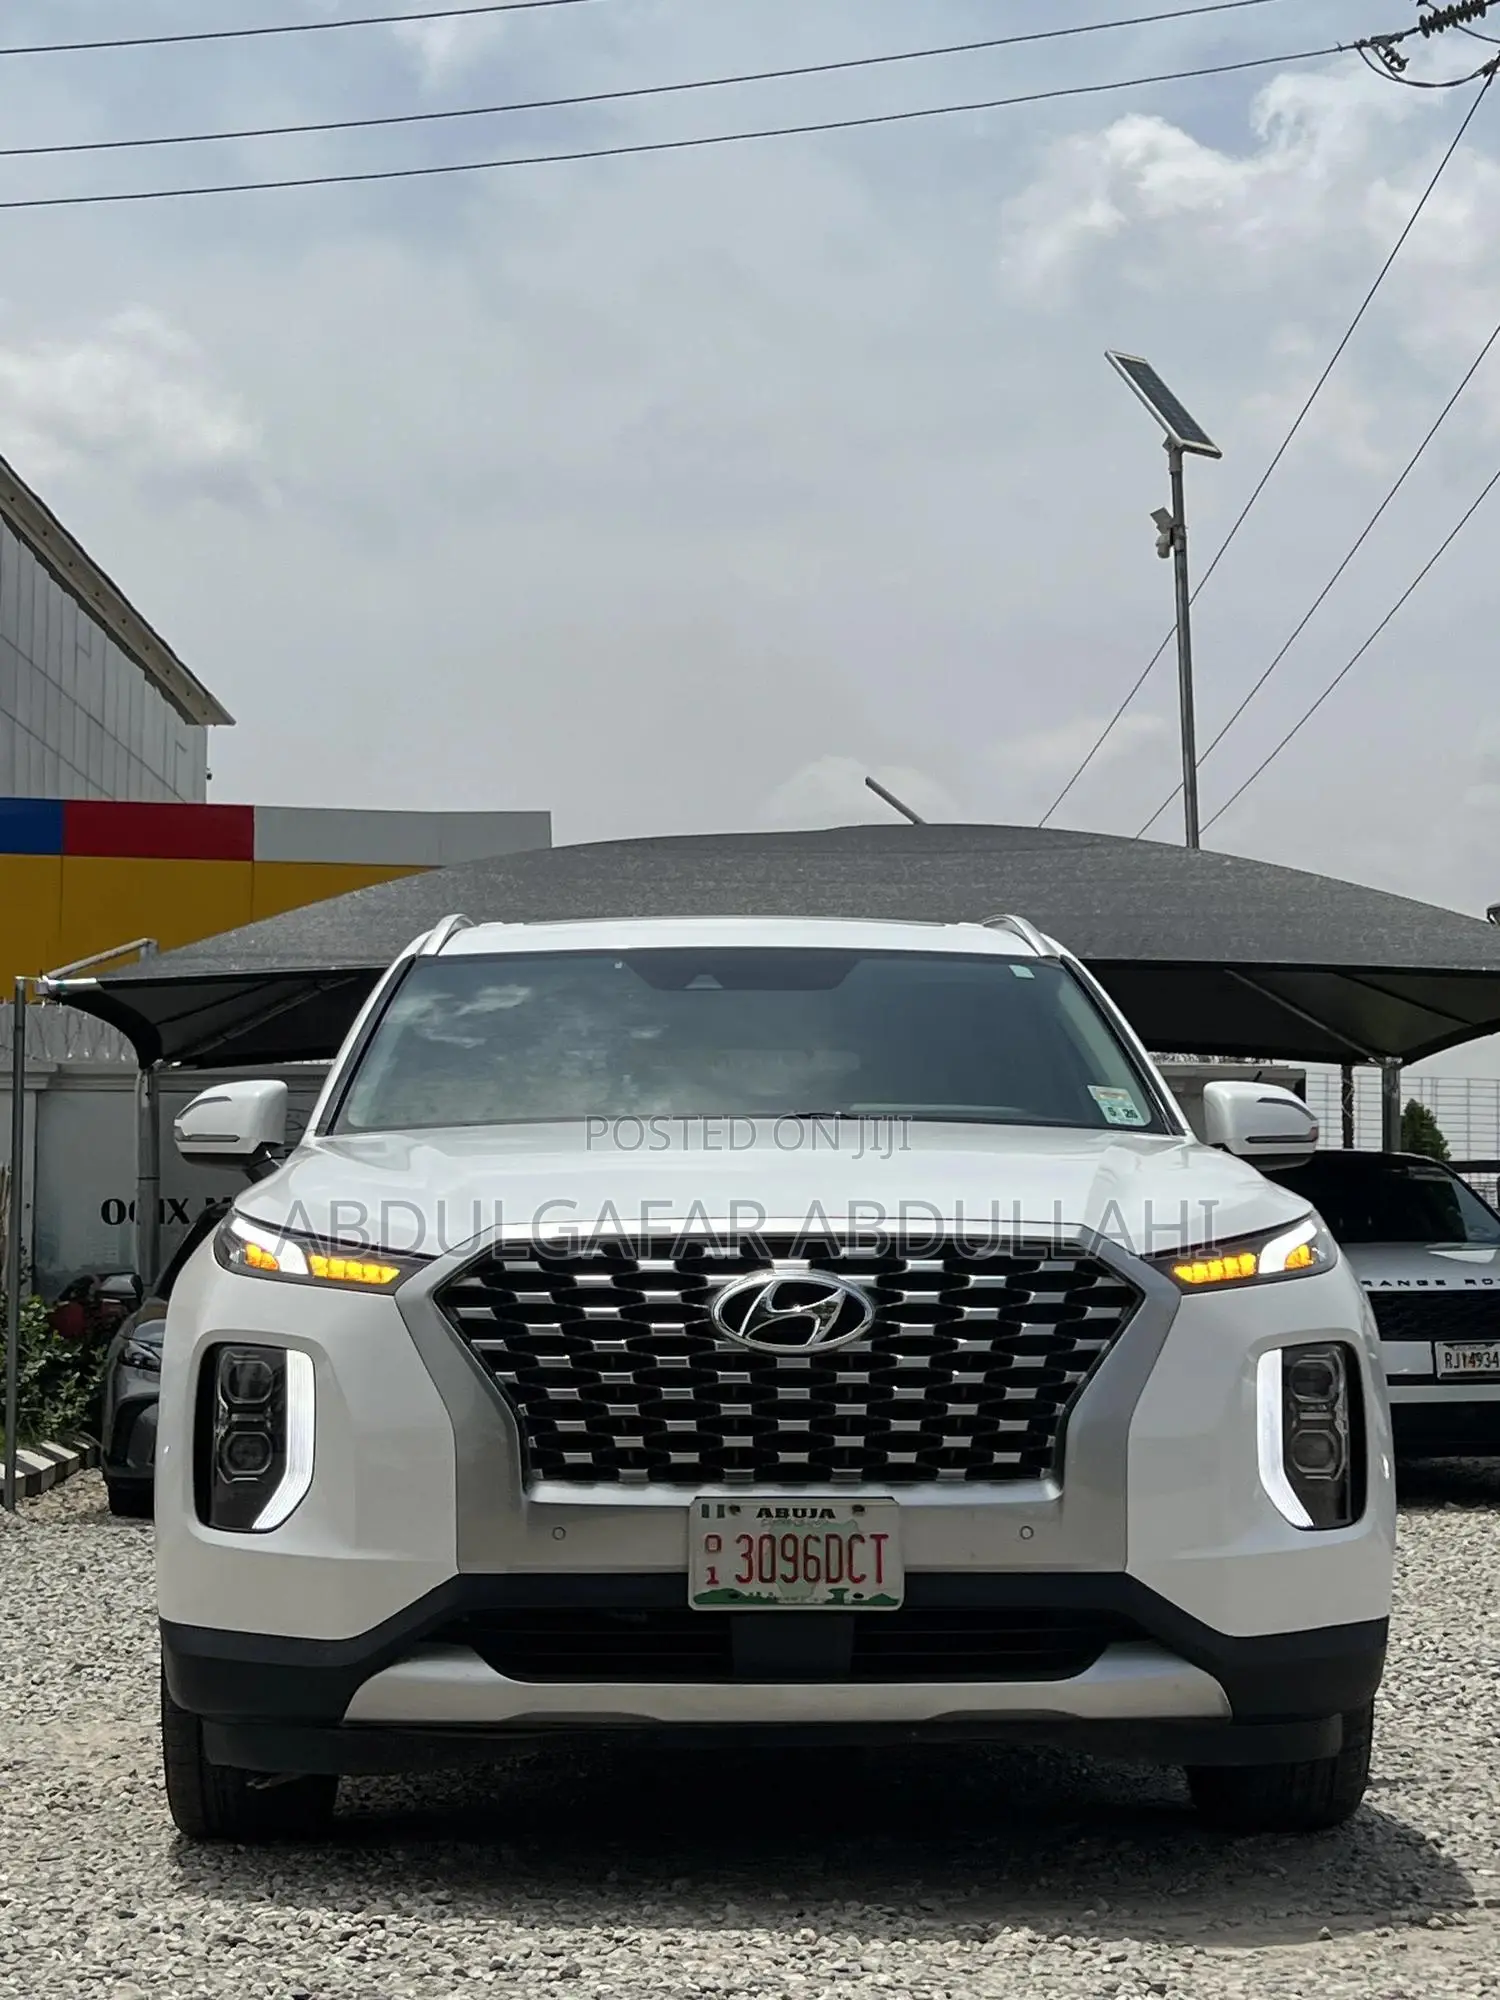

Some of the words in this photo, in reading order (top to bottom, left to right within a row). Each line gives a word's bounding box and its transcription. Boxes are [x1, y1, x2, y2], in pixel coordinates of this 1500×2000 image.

[1361, 1279, 1447, 1287] RANGE
[756, 1507, 836, 1519] ABUJA
[734, 1533, 889, 1585] 3096DCT
